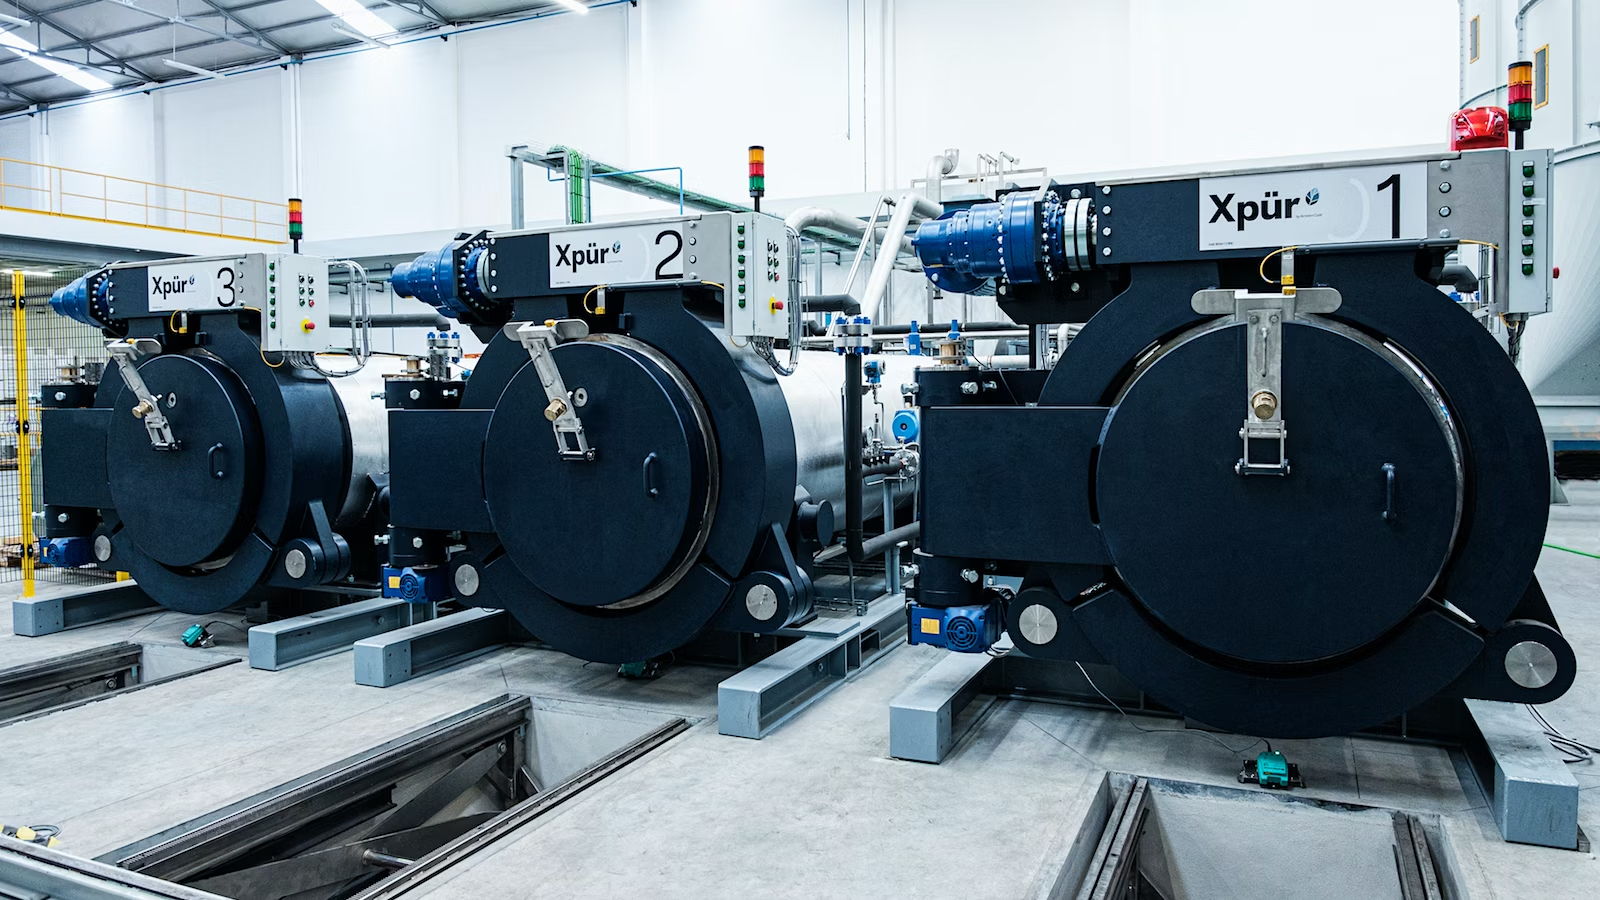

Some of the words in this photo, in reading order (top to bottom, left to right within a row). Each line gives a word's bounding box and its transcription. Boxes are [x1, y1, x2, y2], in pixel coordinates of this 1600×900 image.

[1209, 191, 1300, 231] Xpür
[1377, 174, 1400, 239] 1
[556, 243, 609, 273] Xpür
[655, 230, 683, 280] 2
[153, 276, 187, 299] Xpür
[217, 267, 235, 307] 3
